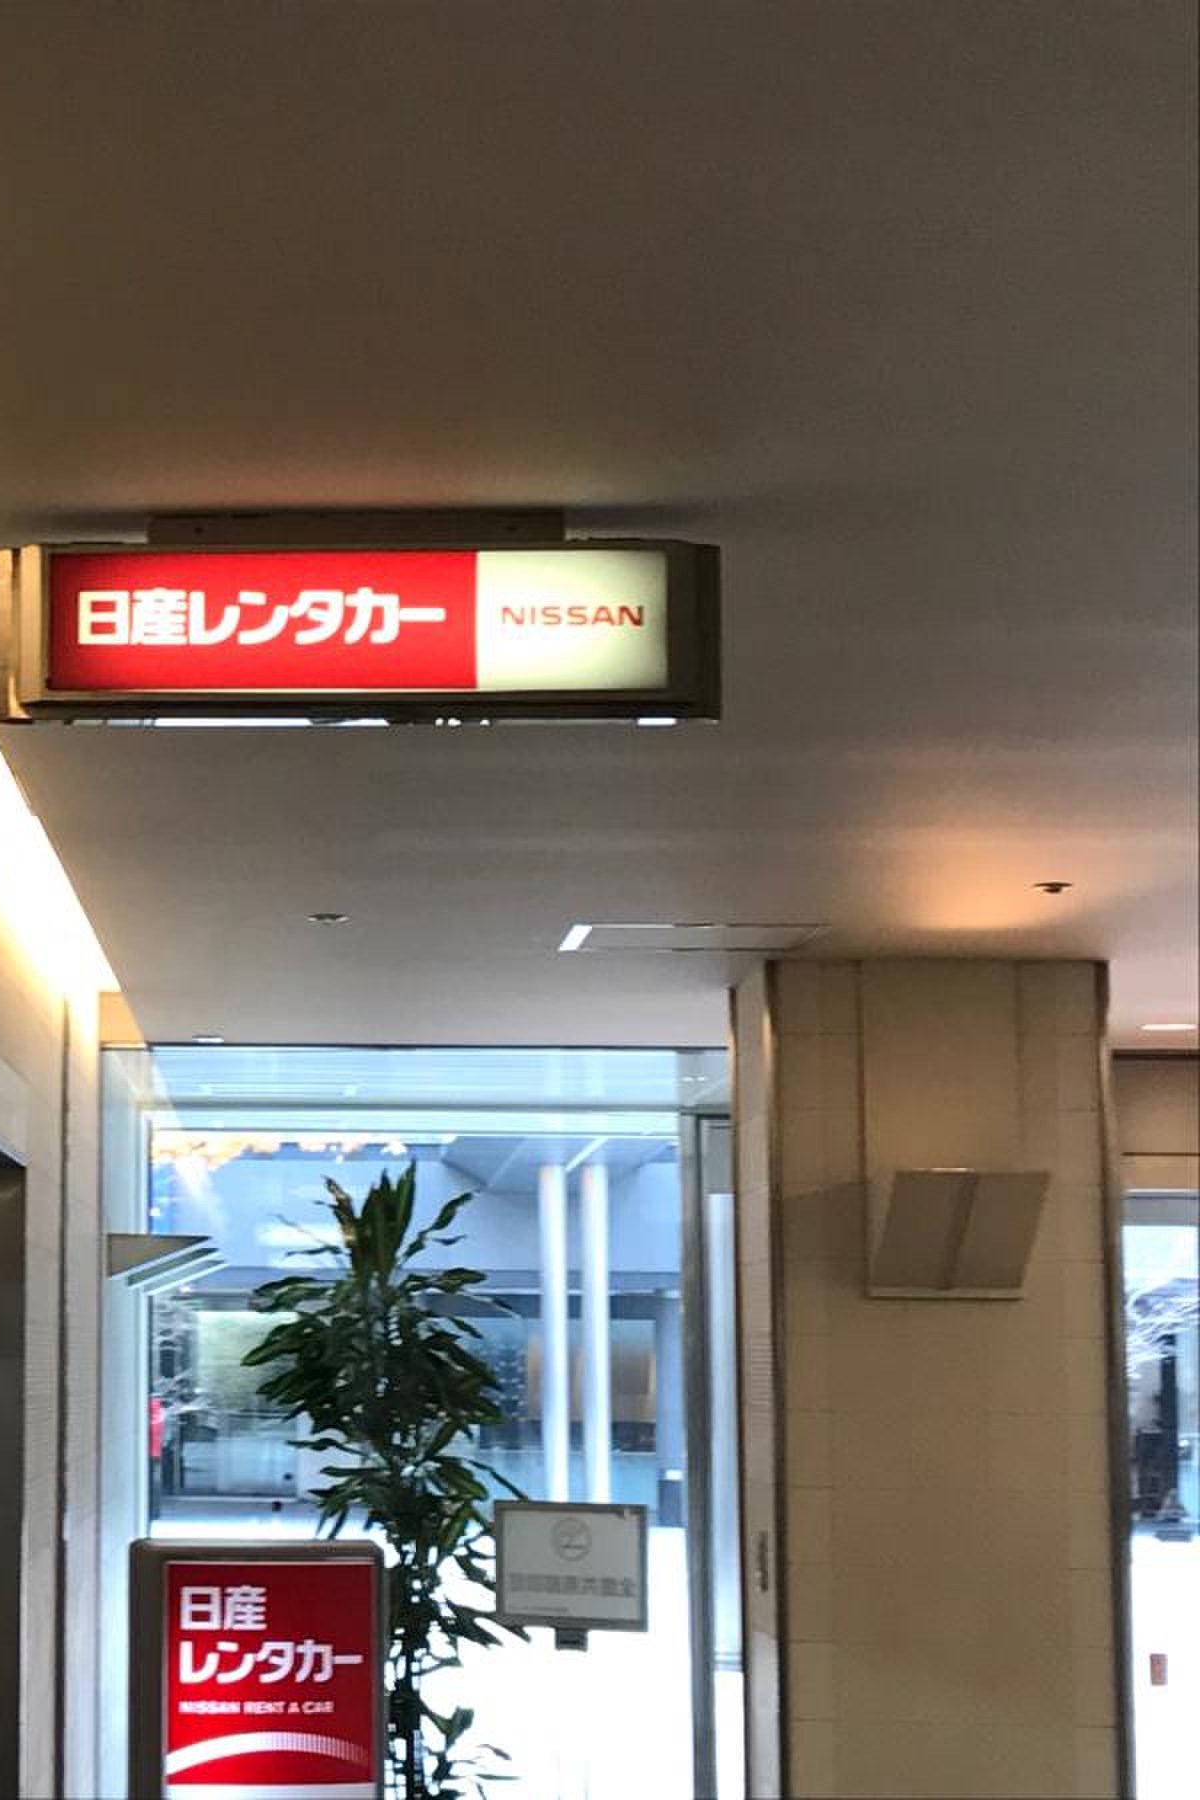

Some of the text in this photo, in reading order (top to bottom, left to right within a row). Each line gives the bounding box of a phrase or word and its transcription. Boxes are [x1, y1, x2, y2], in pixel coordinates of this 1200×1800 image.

[78, 586, 447, 646] 日産レンタカー
[500, 604, 644, 627] NISSAN
[180, 1585, 267, 1631] 日産
[179, 1639, 363, 1684] レンタカー
